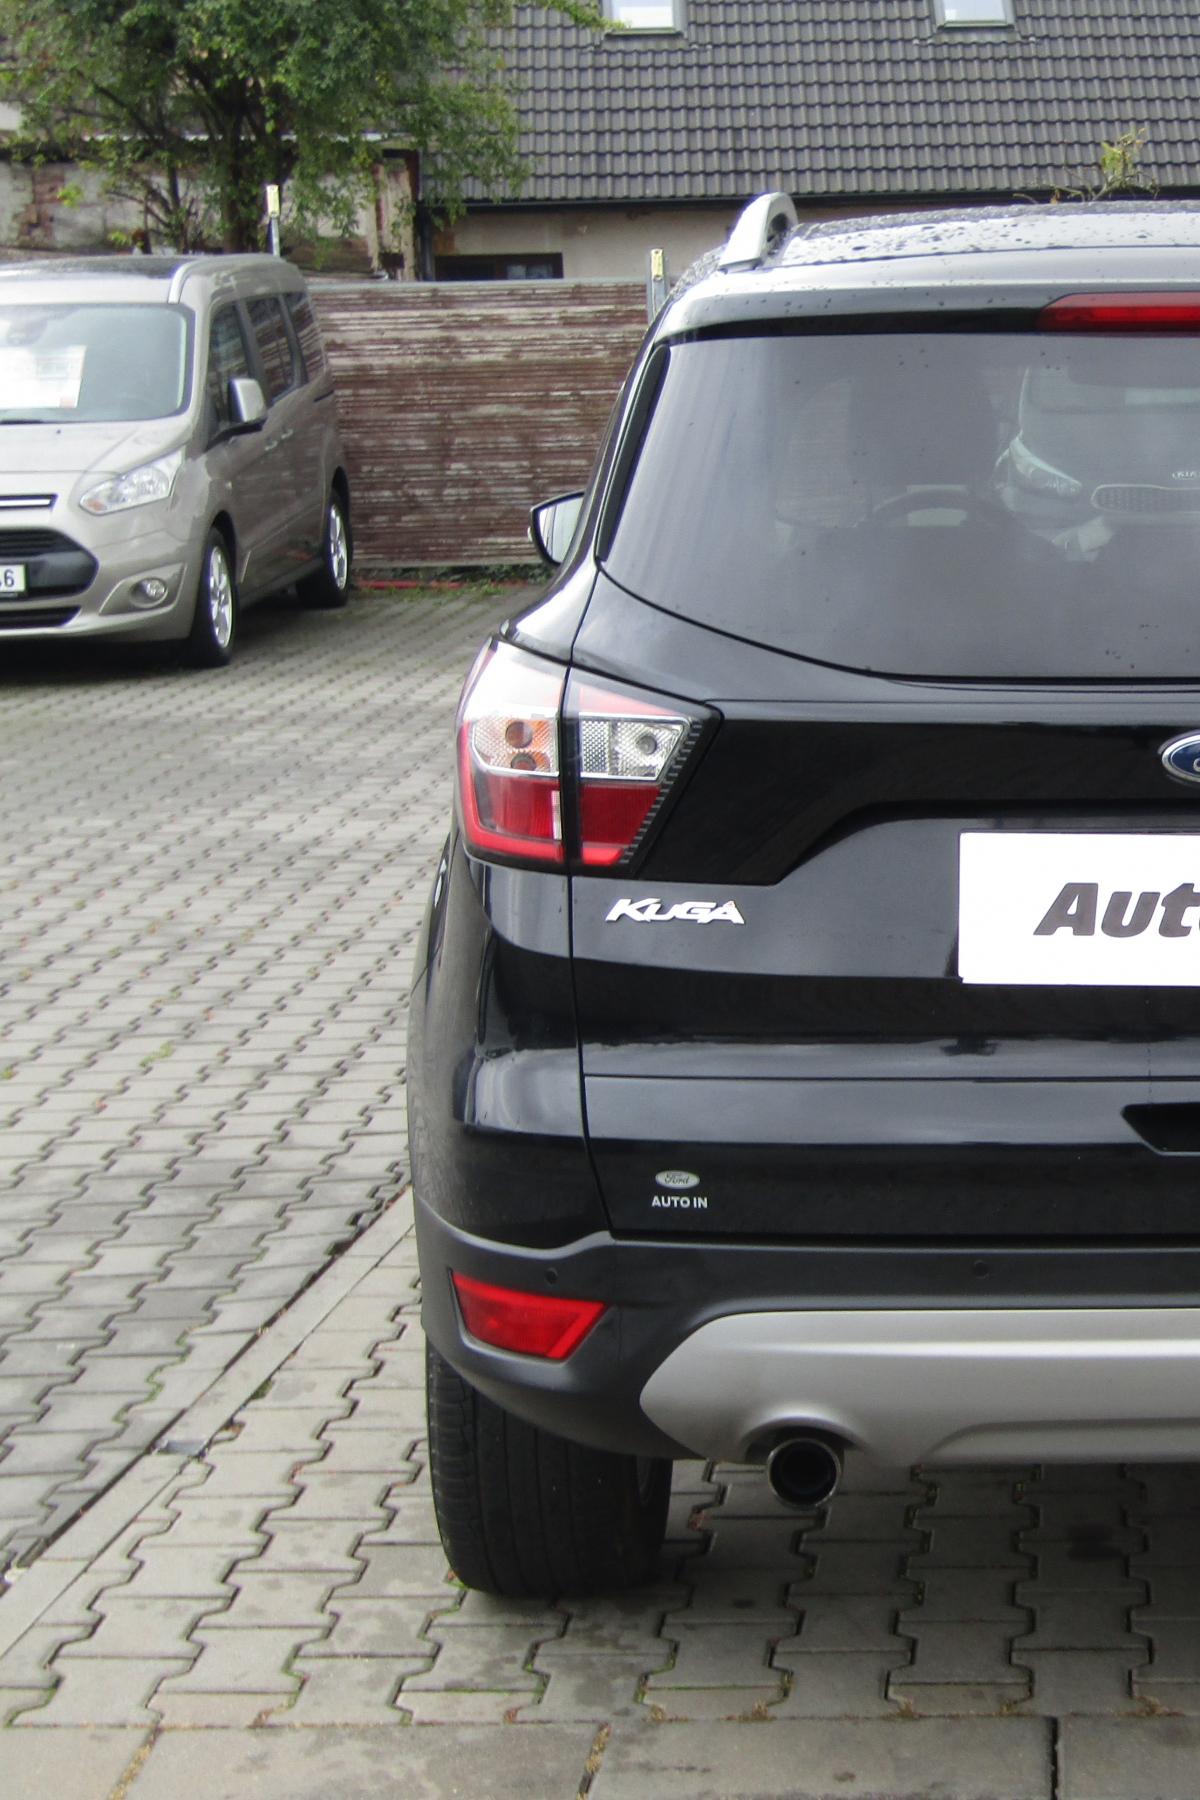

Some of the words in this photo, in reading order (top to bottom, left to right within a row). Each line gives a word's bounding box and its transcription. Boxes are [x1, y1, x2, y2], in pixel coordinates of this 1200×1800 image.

[0, 569, 15, 588] 6
[605, 897, 745, 925] KUGA
[664, 1171, 690, 1185] Ford
[651, 1195, 691, 1208] AUTO
[693, 1196, 708, 1209] IN
